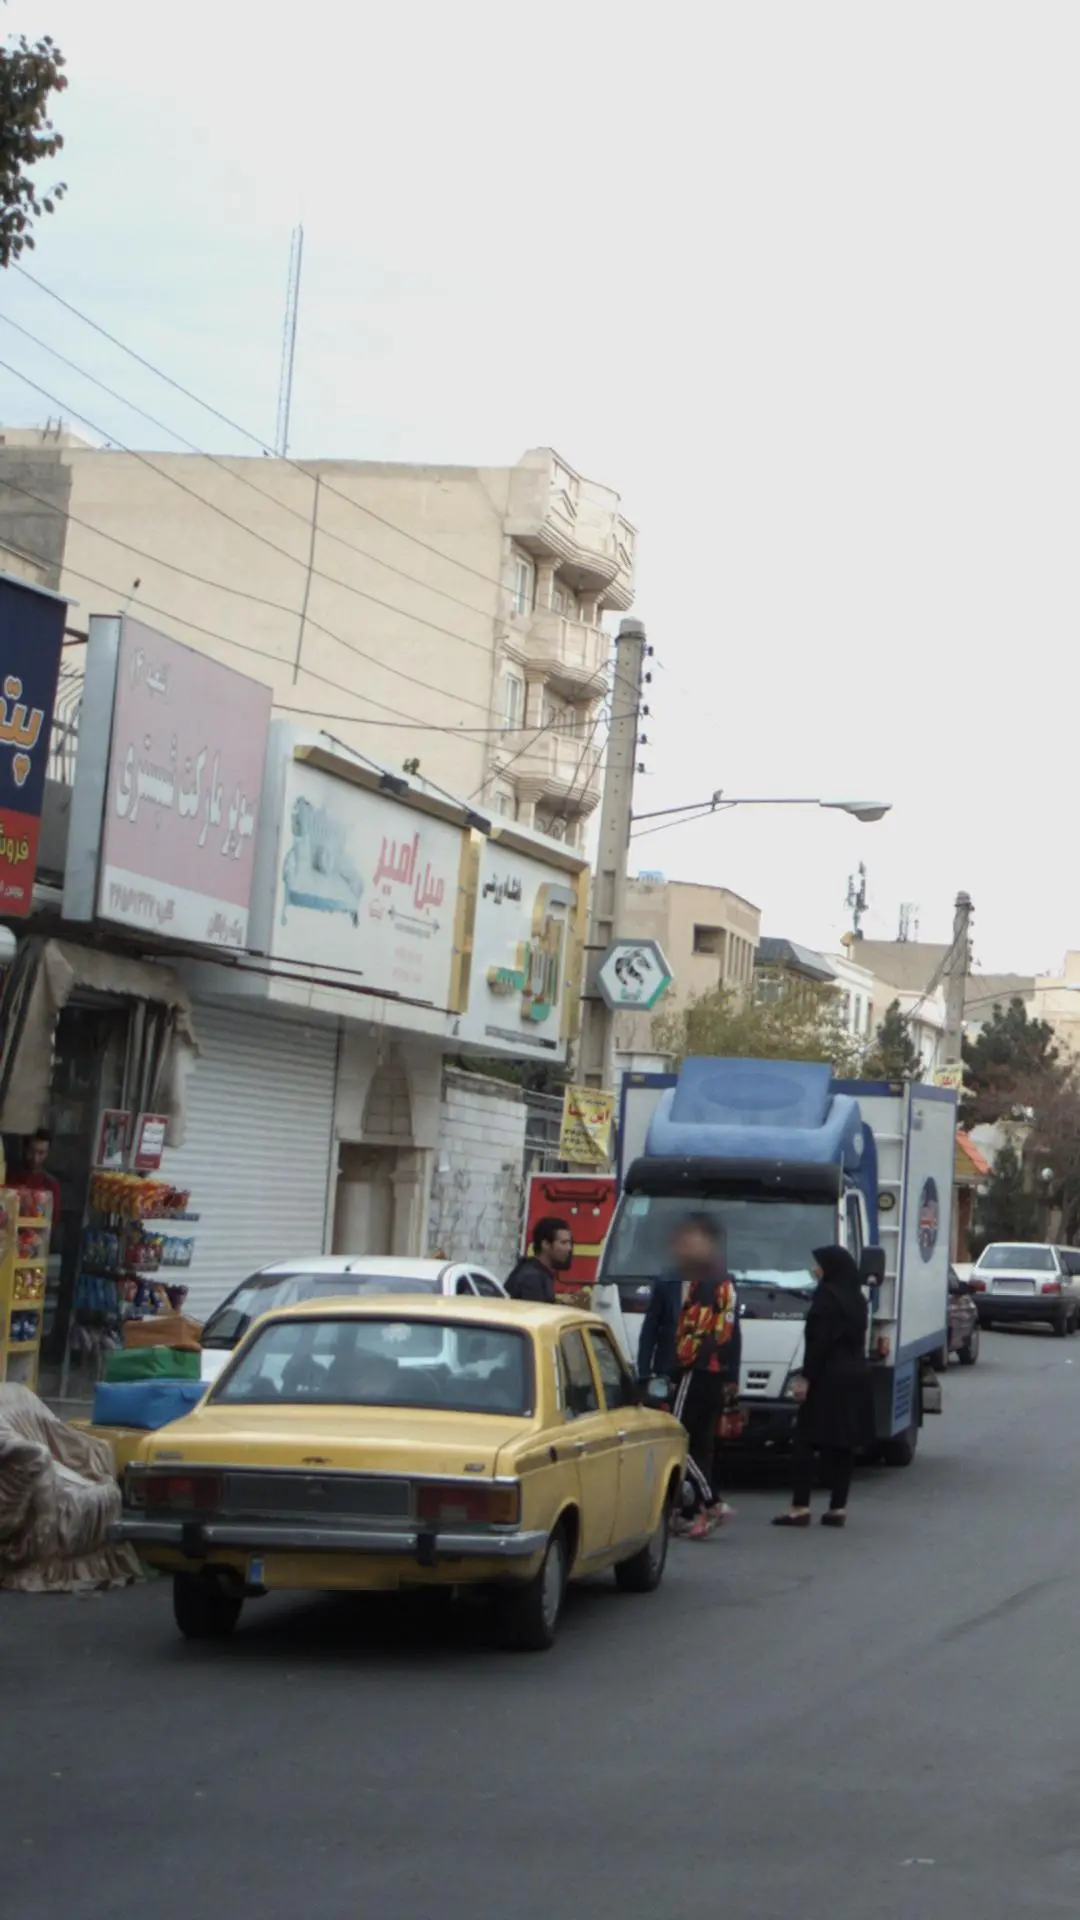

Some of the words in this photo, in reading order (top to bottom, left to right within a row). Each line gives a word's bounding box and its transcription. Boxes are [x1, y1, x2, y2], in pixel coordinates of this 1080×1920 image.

[178, 745, 223, 848] مارکت
[221, 781, 255, 860] سوپر
[372, 830, 421, 898] امیر
[413, 861, 446, 916] مبل
